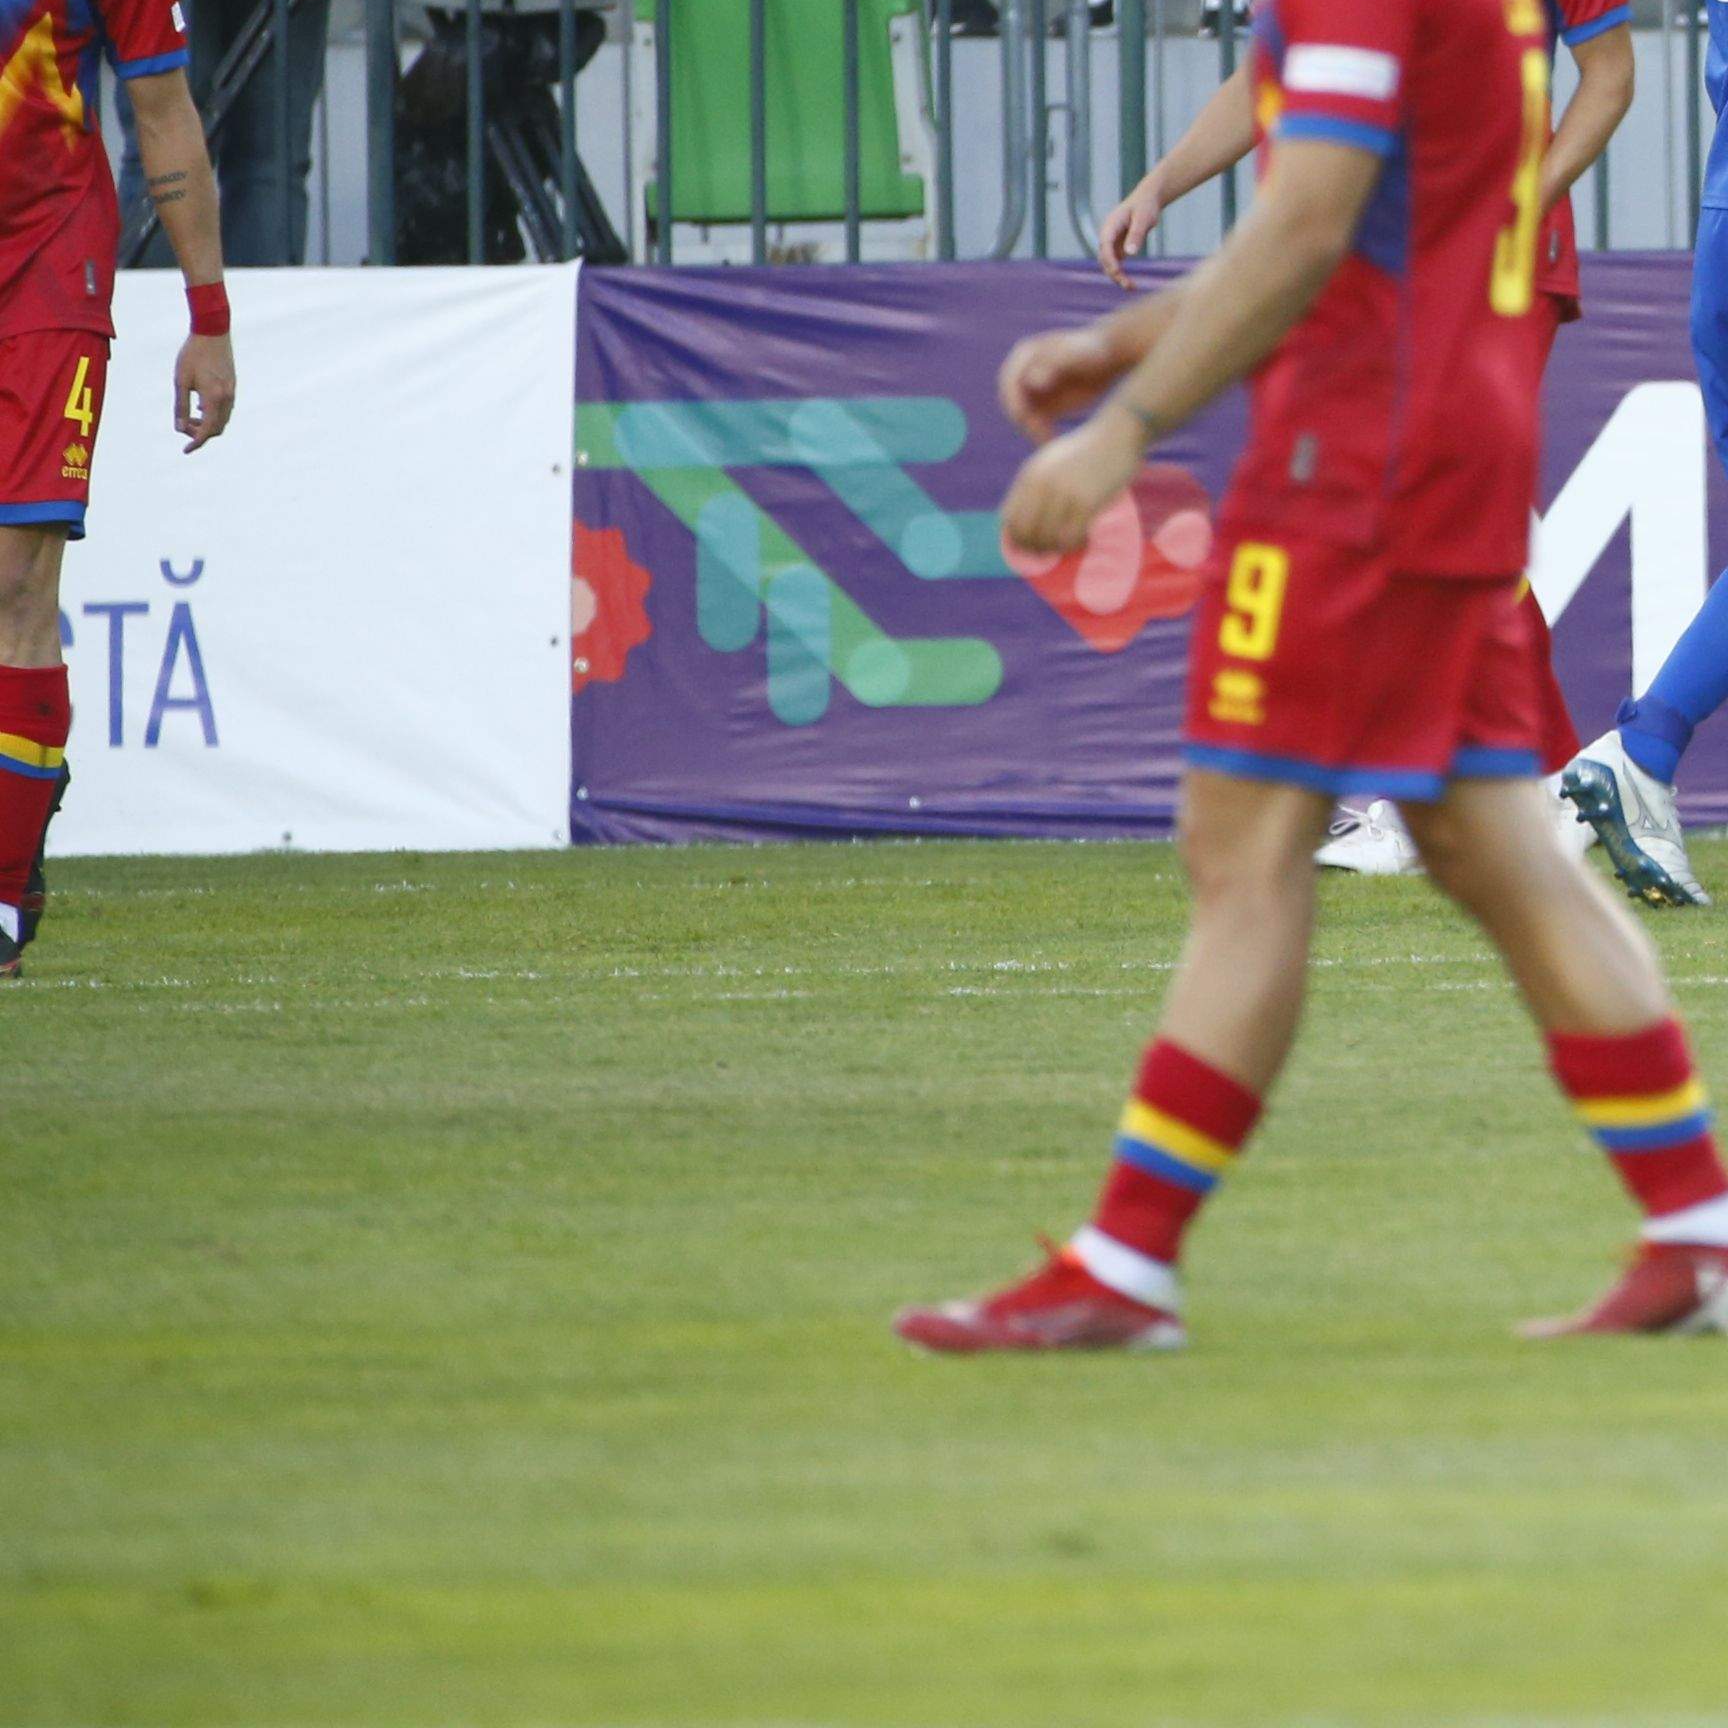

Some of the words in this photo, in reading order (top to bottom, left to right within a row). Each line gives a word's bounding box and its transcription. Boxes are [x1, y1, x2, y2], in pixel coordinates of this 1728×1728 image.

[64, 356, 93, 437] 4
[60, 557, 220, 749] TĂ
[1219, 540, 1288, 662] 9
